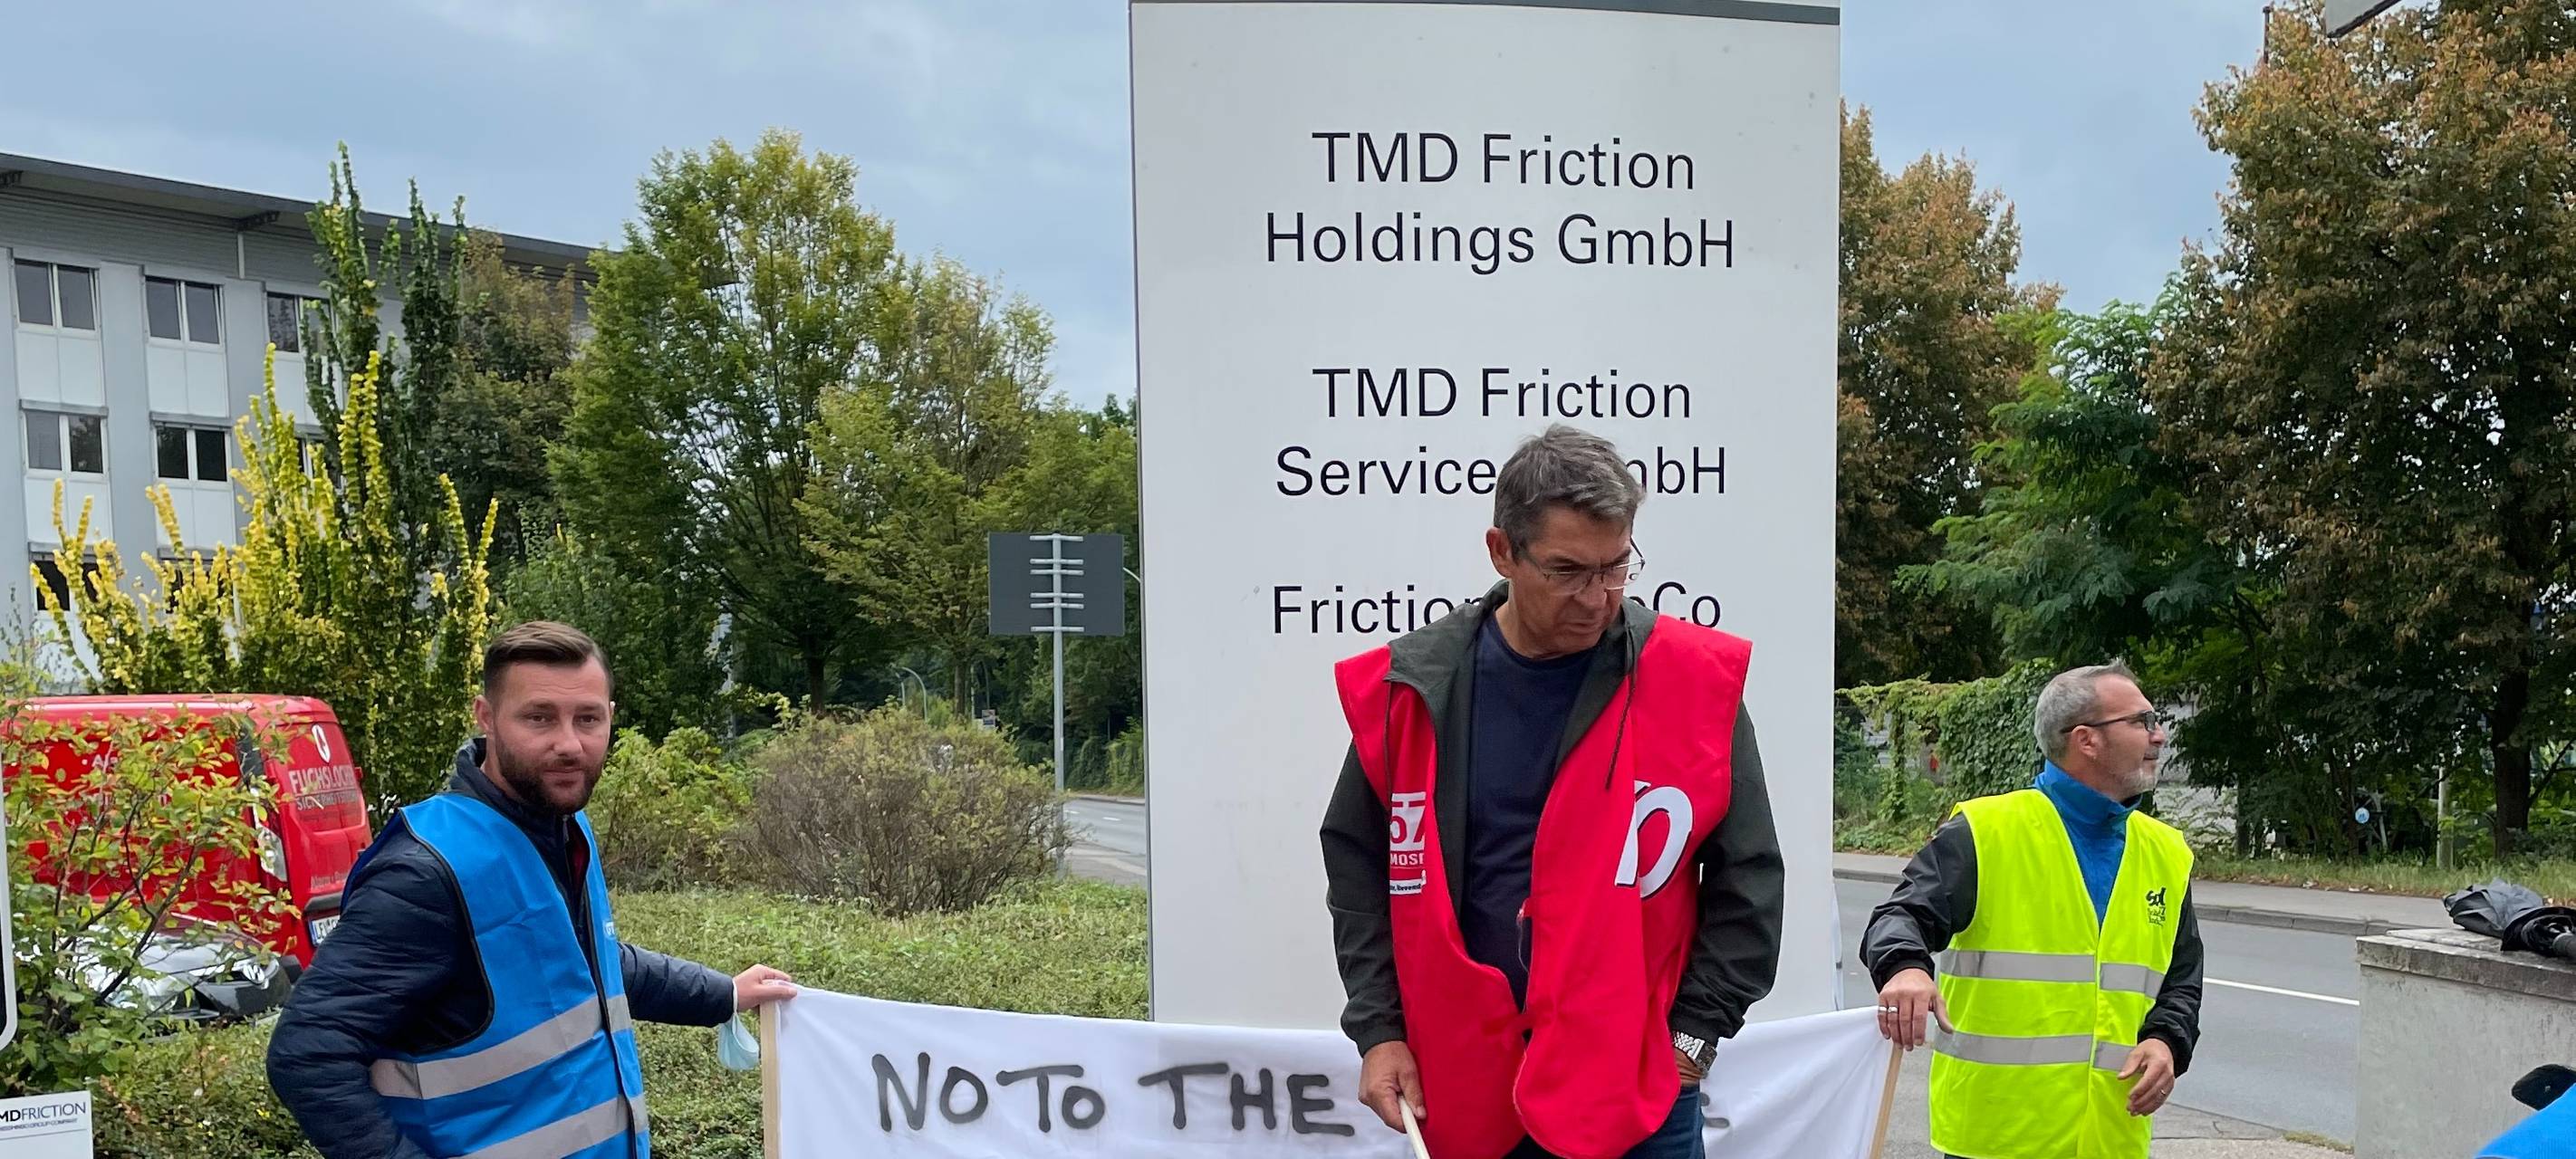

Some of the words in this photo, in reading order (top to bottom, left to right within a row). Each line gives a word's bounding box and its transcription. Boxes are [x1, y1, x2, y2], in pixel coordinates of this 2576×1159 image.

[1312, 131, 1458, 183] TMD
[1484, 133, 1694, 190] Friction
[1267, 211, 1534, 275] Holdings
[1558, 213, 1733, 268] GmbH
[1312, 368, 1457, 418] TMD
[1482, 368, 1690, 418] Friction
[1276, 445, 1496, 496] Service
[1626, 446, 1725, 494] bH
[1274, 584, 1484, 634] Frictio
[1629, 581, 1721, 628] Co
[871, 1051, 989, 1133] NO
[1137, 1061, 1356, 1137] THE
